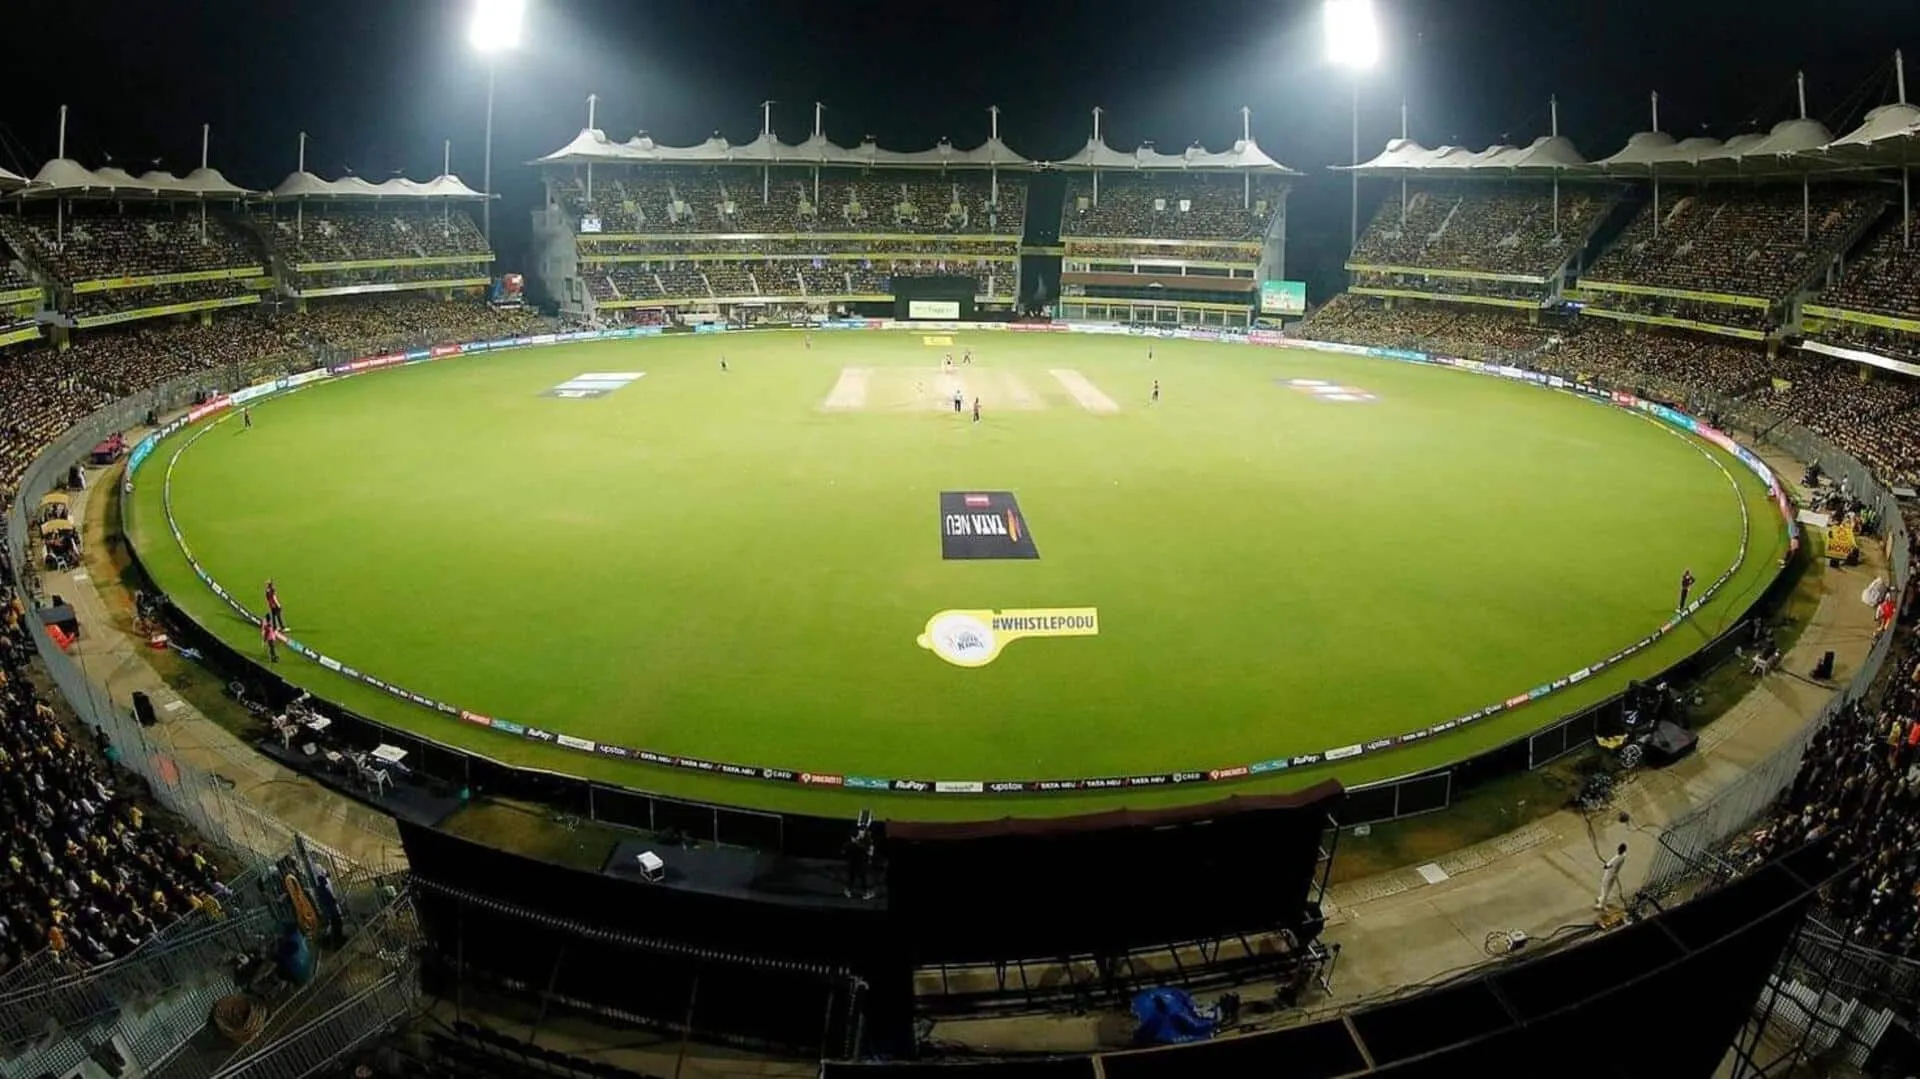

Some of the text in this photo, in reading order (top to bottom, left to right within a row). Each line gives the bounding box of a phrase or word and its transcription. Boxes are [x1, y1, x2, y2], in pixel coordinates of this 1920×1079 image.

[946, 514, 1007, 535] TATA NEU
[992, 616, 1094, 631] #WHISTLEPODU
[895, 780, 924, 792] RuPay
[1040, 782, 1060, 790] TATA
[1131, 777, 1149, 785] TATA
[990, 782, 1023, 791] upstox
